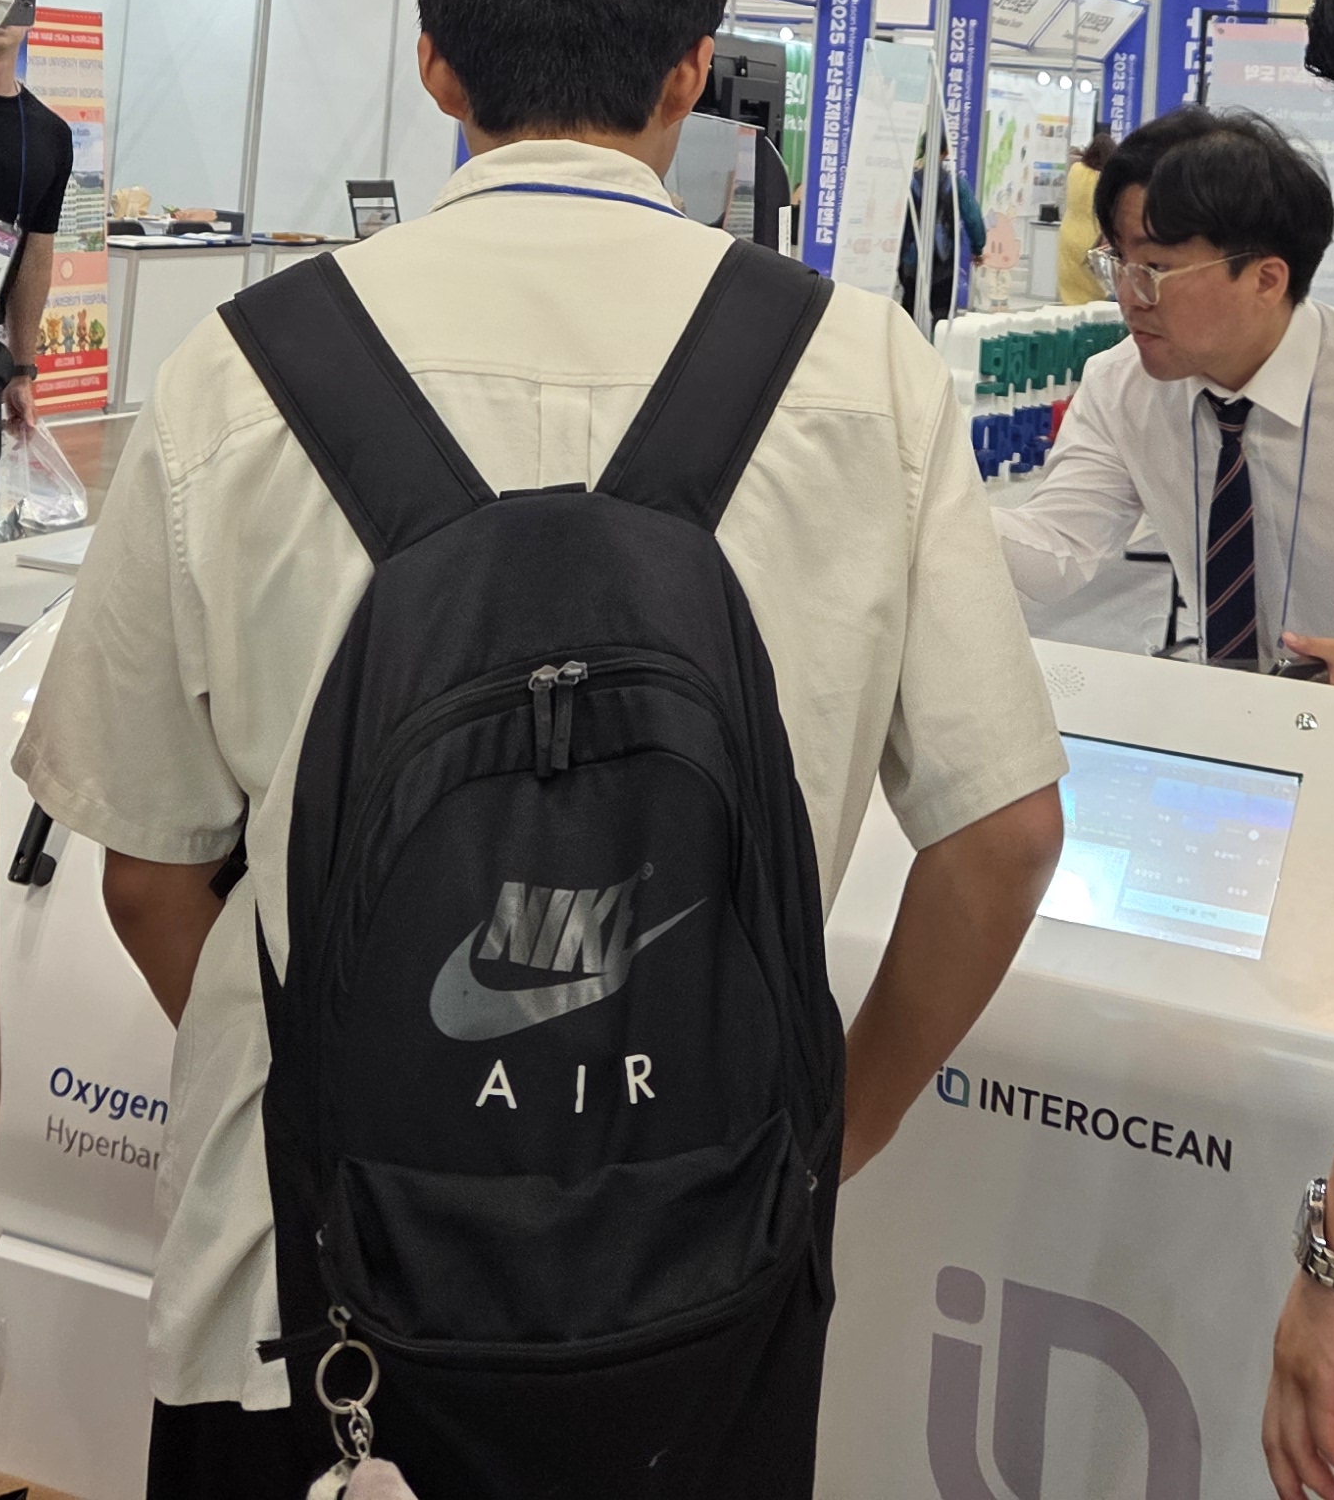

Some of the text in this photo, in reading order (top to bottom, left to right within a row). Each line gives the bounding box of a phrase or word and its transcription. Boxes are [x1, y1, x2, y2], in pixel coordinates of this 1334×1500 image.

[950, 17, 967, 63] 2025
[1112, 52, 1127, 91] 2025
[48, 1066, 169, 1126] Oxygen
[475, 1053, 656, 1114] AIR
[978, 1076, 1235, 1173] INTEROCEAN
